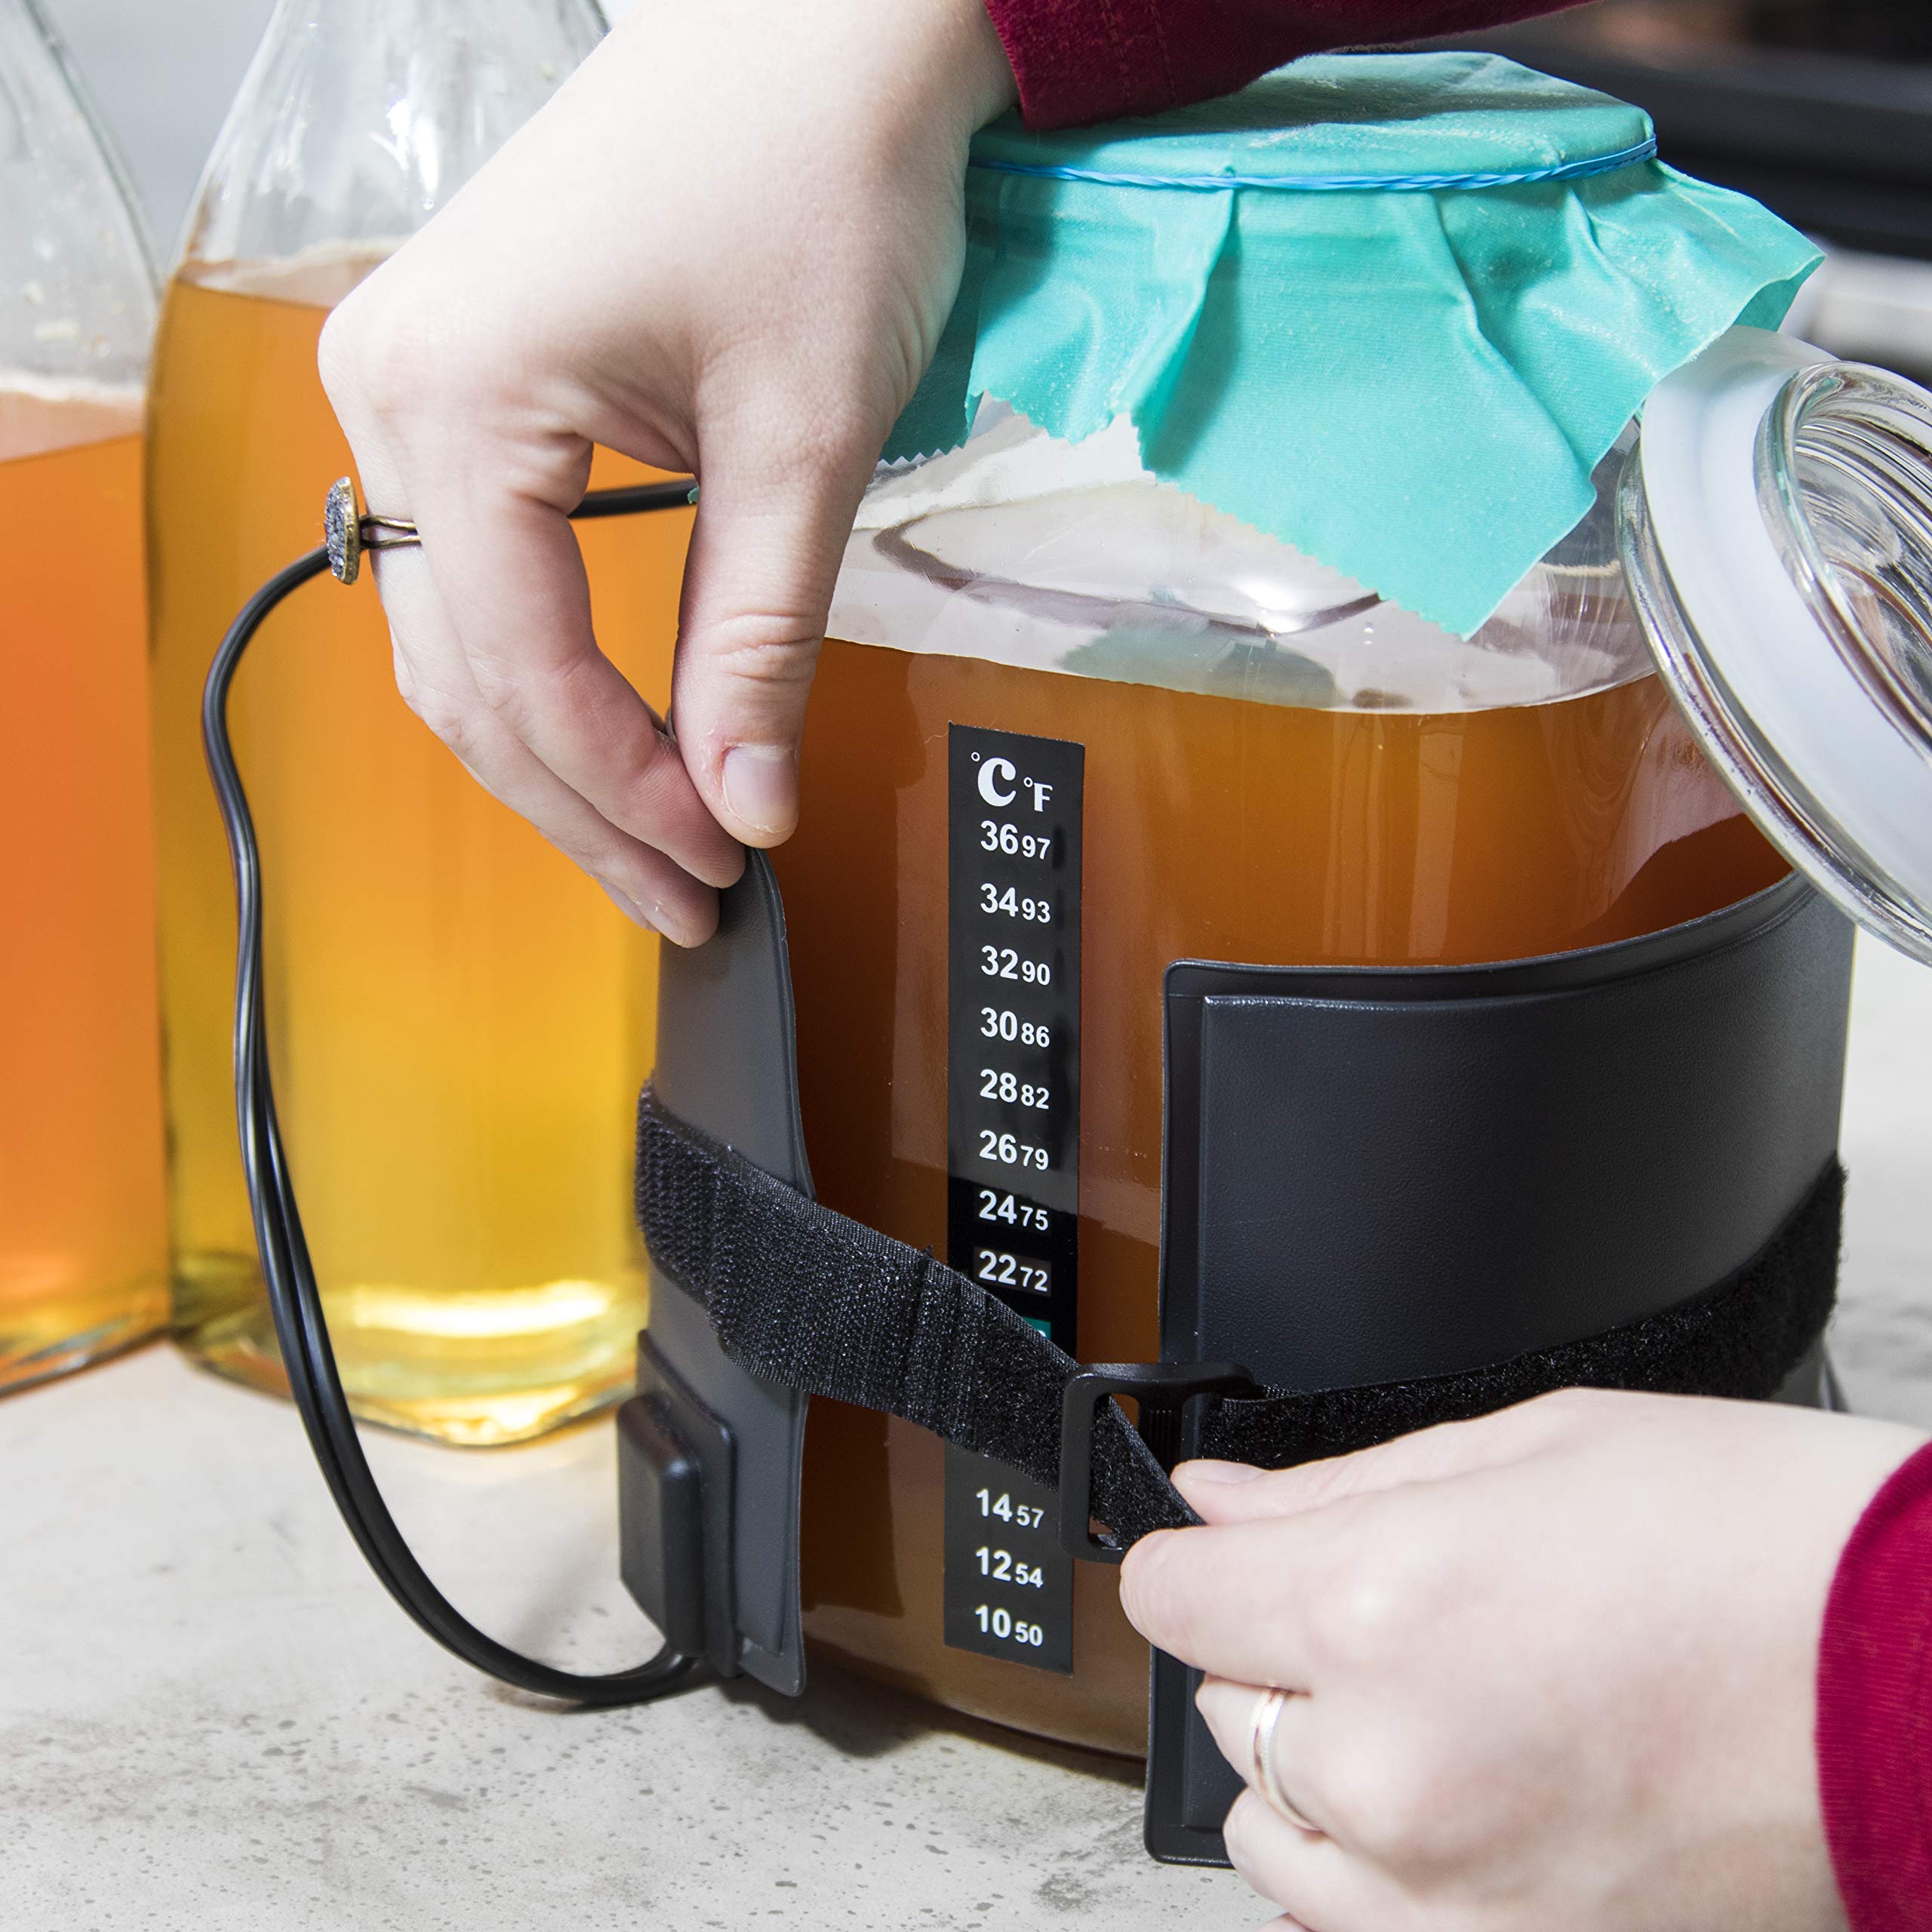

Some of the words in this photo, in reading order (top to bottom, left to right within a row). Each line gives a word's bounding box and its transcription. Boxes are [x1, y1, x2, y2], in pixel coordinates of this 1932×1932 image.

[980, 820, 1019, 855] 36
[1022, 835, 1051, 860] 97
[980, 883, 1019, 918] 34
[1021, 898, 1051, 924] 93
[980, 945, 1019, 980] 32
[1021, 960, 1051, 986] 90
[980, 1007, 1018, 1041] 30
[1020, 1022, 1050, 1048] 86
[980, 1069, 1018, 1103] 28
[1020, 1084, 1050, 1109] 82
[979, 1129, 1017, 1164] 26
[1020, 1144, 1049, 1171] 79
[979, 1190, 1017, 1225] 24
[1020, 1205, 1048, 1231] 75
[979, 1251, 1017, 1285] 22
[1019, 1266, 1048, 1292] 72
[976, 1488, 1013, 1522] 14
[1016, 1504, 1044, 1528] 57
[975, 1547, 1012, 1581] 12
[1015, 1563, 1044, 1589] 54
[974, 1604, 1011, 1638] 10
[1014, 1622, 1043, 1647] 50
